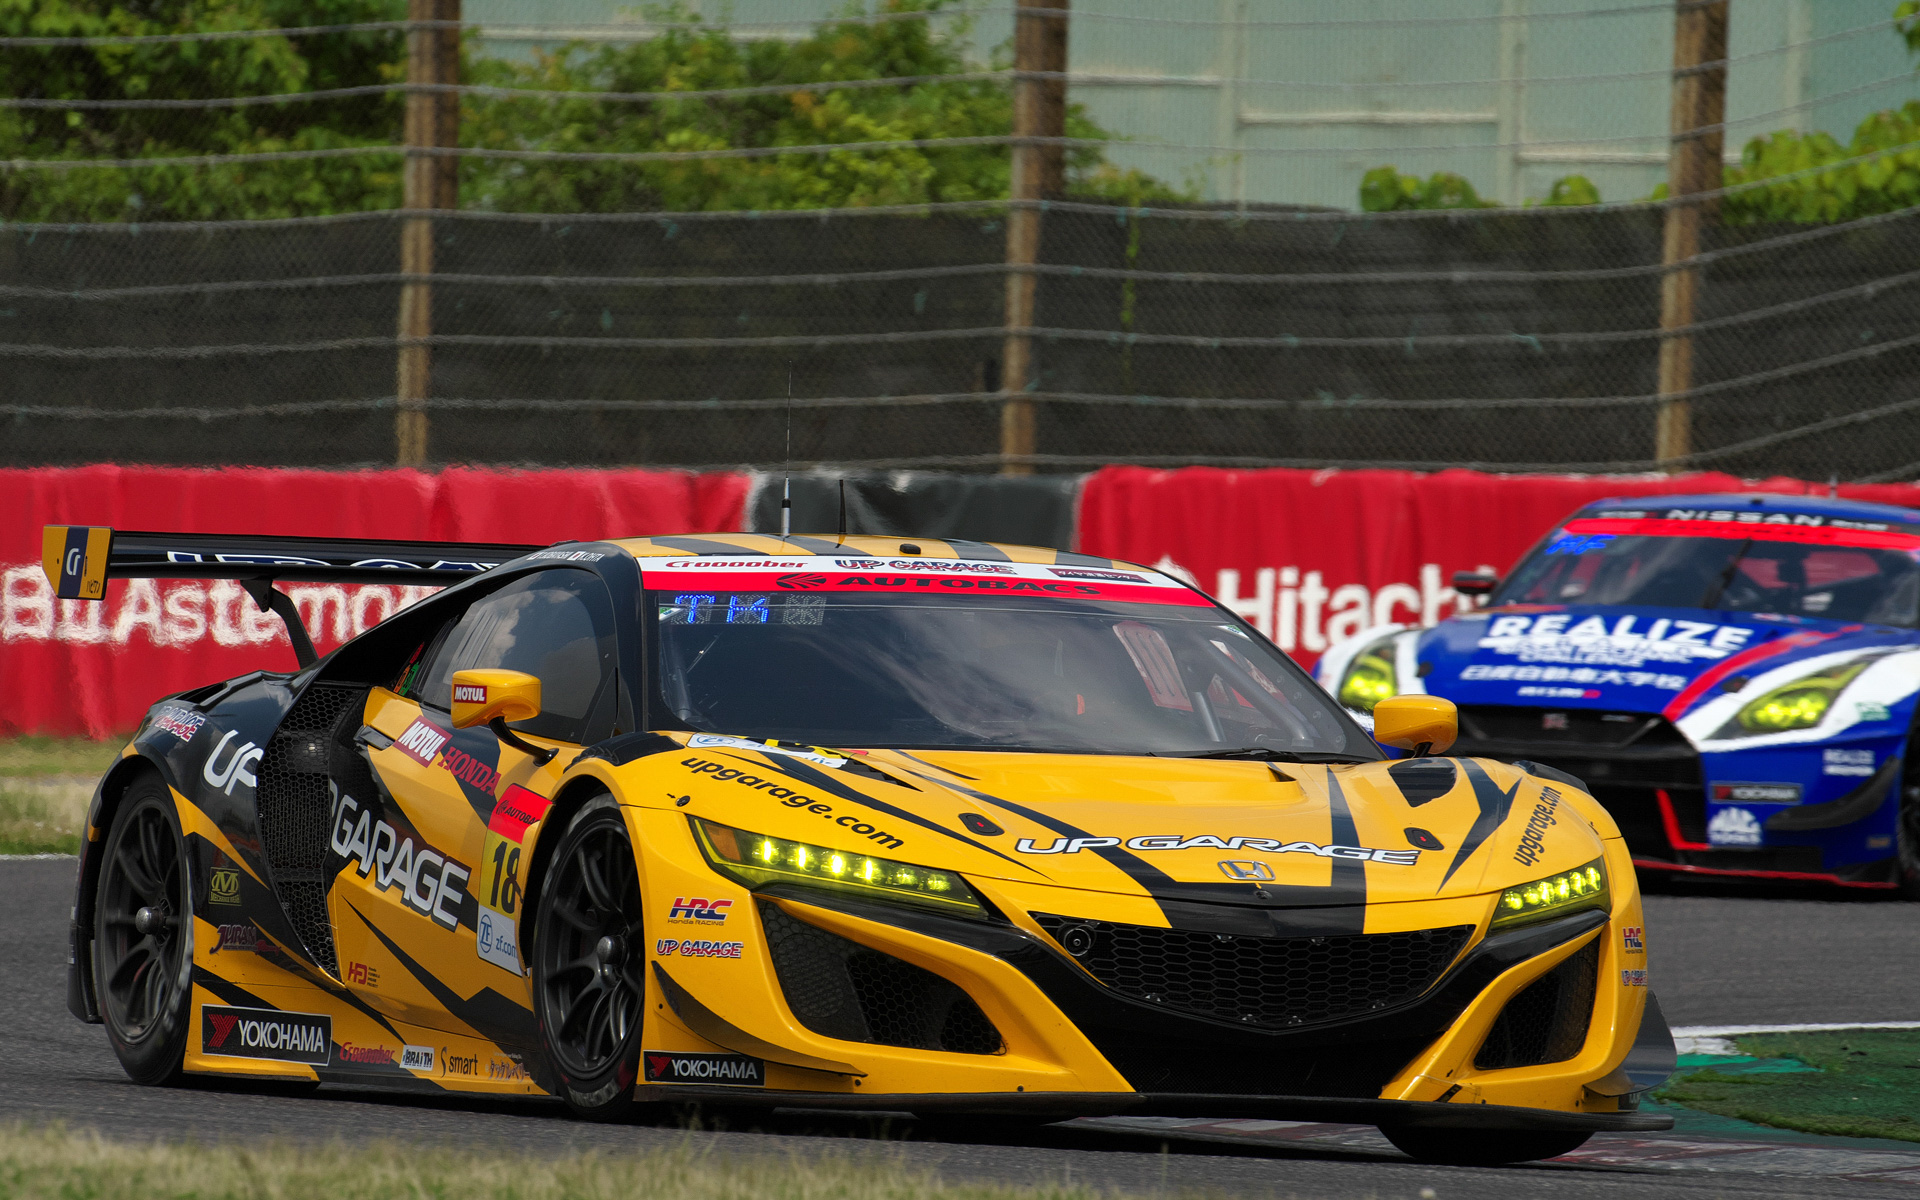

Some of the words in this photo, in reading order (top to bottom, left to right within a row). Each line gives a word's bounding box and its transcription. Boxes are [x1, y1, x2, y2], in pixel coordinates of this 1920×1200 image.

[1666, 509, 1823, 527] NISSAN
[666, 560, 808, 568] Croooober
[834, 559, 886, 570] UP
[888, 560, 1017, 575] GARAGE
[837, 576, 1101, 595] AUTOBACS
[1489, 614, 1754, 650] REALIZE
[454, 686, 486, 702] MOTUL
[398, 721, 446, 761] MOTUL
[437, 746, 501, 797] HONDA
[680, 756, 905, 850] upgarage.com
[505, 806, 541, 825] AUTOBA
[1513, 785, 1562, 867] upgarage.com
[331, 794, 471, 930] GARAGE
[1016, 836, 1120, 854] UP
[1126, 834, 1422, 866] GARAGE
[490, 840, 521, 914] 18
[669, 896, 735, 921] HRC
[656, 939, 680, 956] UP
[680, 939, 744, 959] GARAGE
[238, 1019, 325, 1053] YOKOHAMA
[449, 1053, 478, 1076] smart
[672, 1058, 758, 1080] YOKOHAMA
